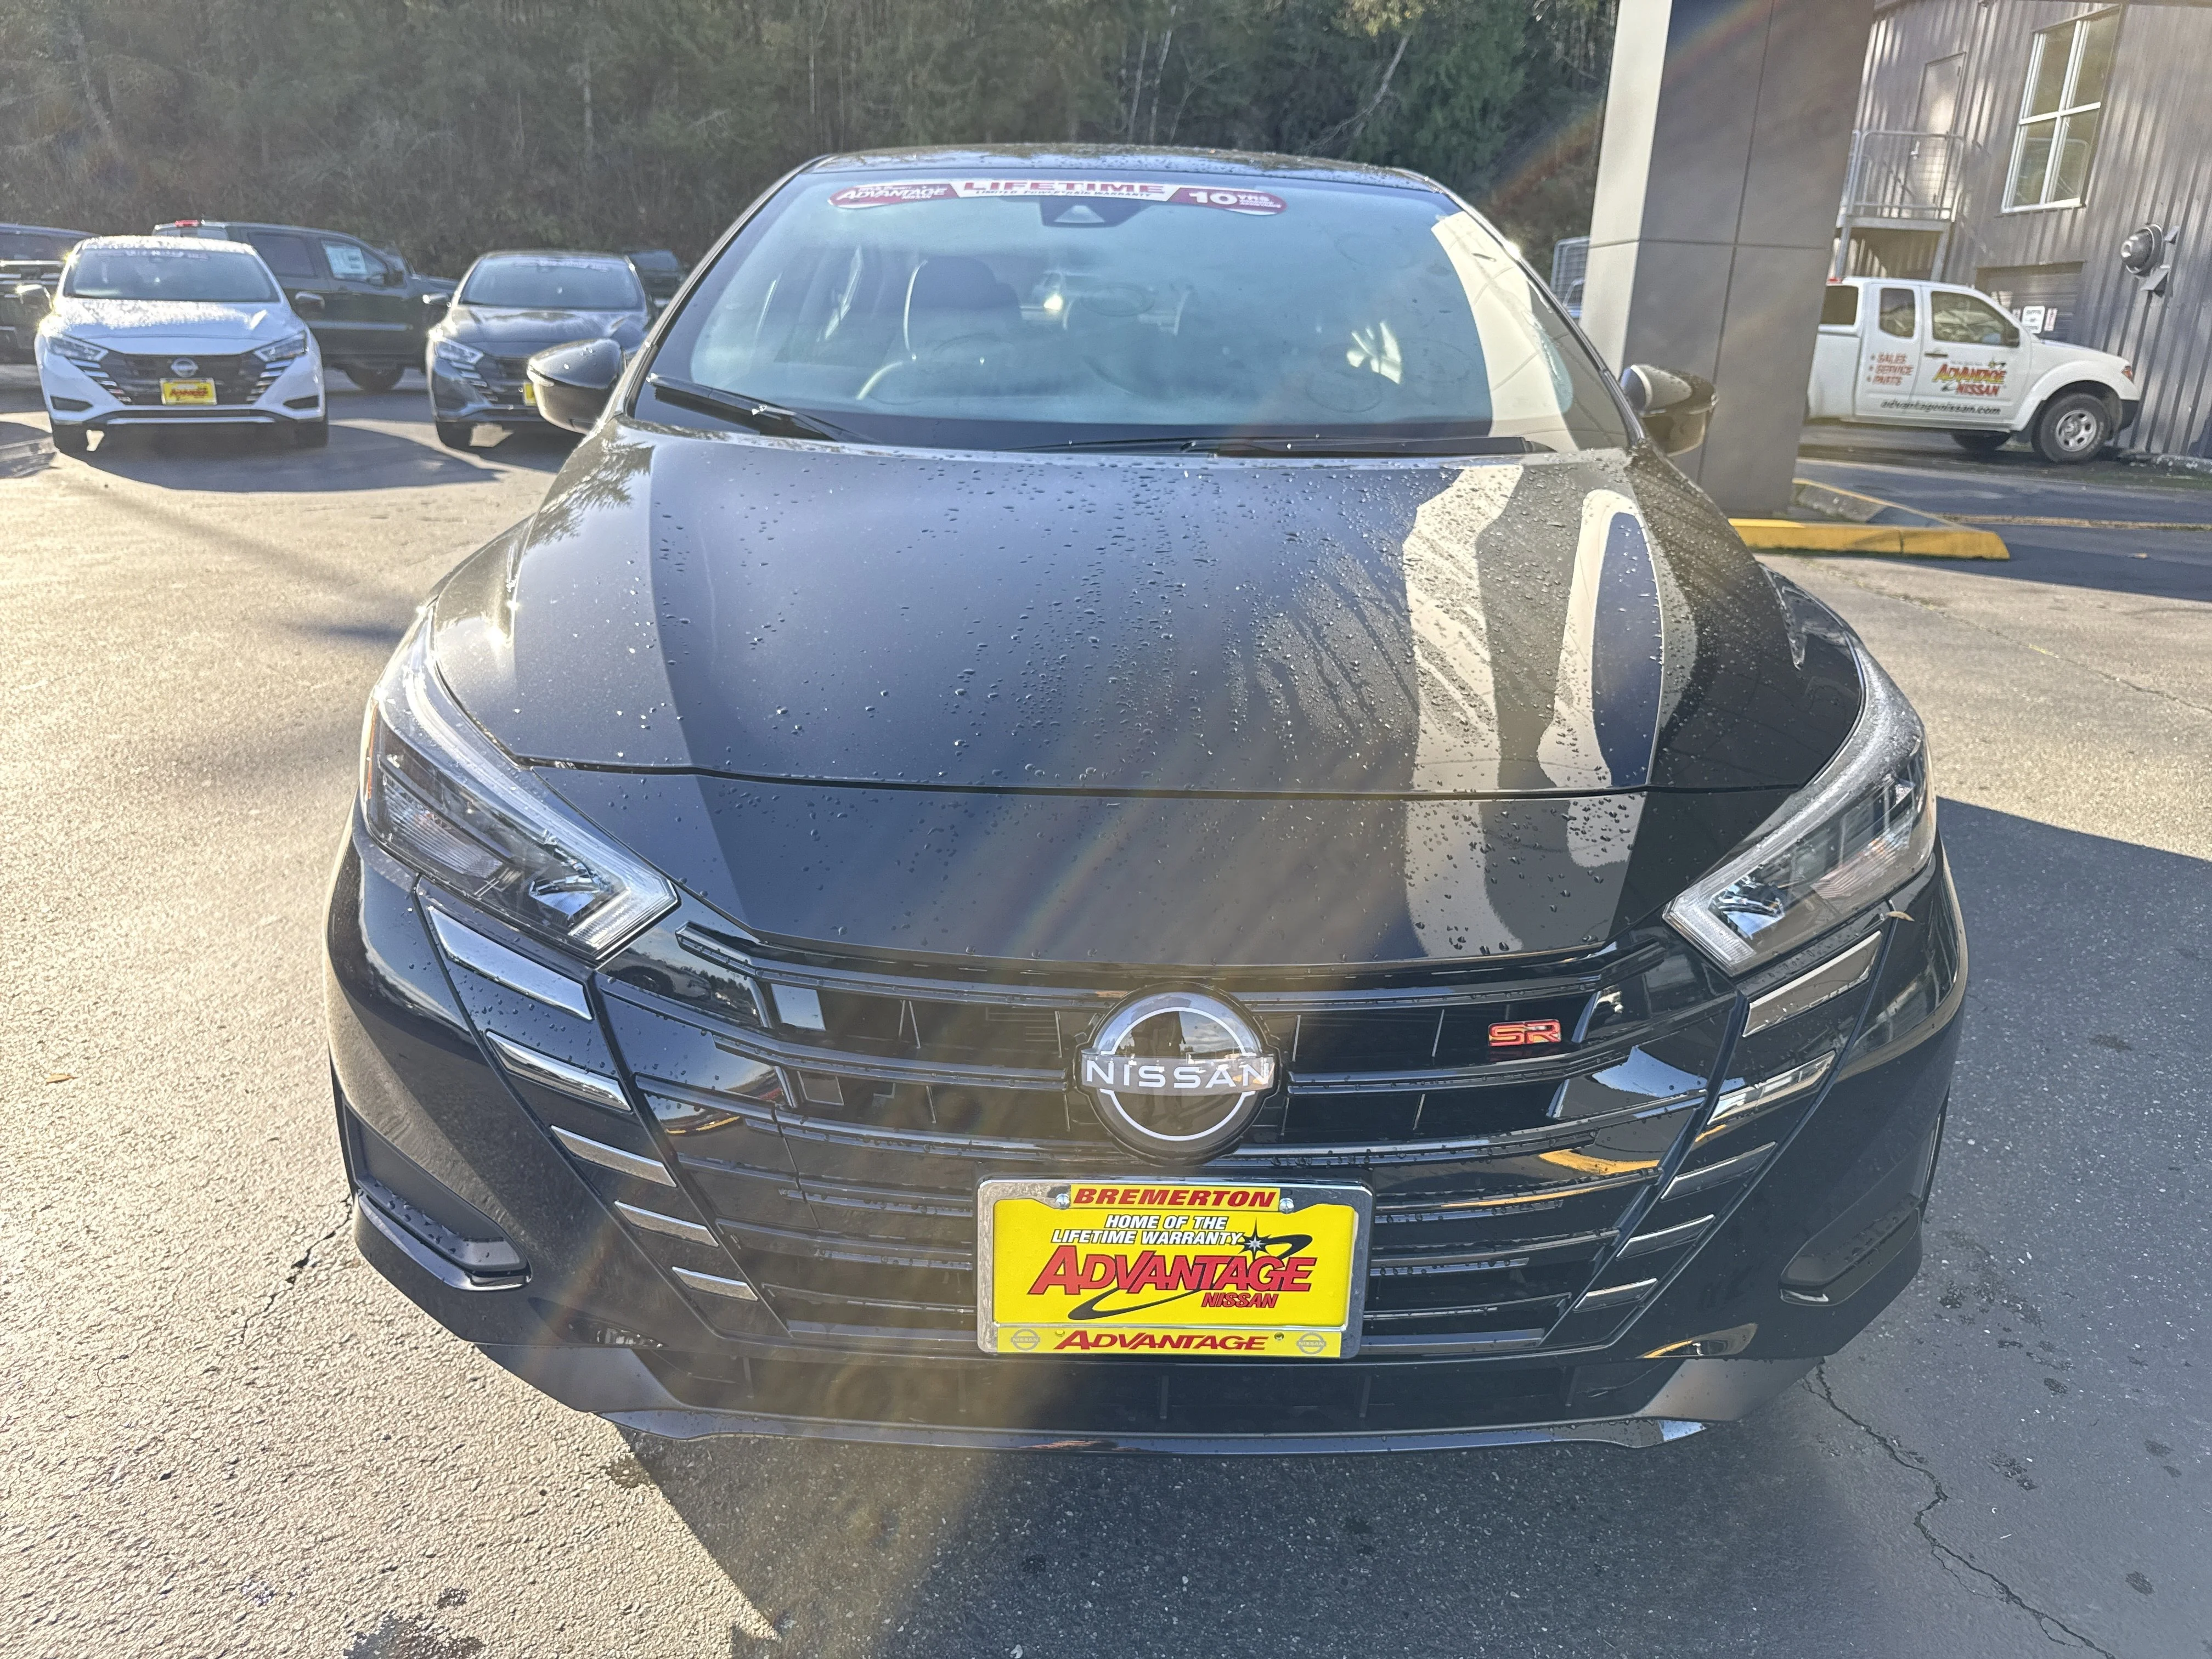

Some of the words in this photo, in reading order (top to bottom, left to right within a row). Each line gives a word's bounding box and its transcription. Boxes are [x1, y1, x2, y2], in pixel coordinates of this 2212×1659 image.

[836, 187, 947, 200] ADVANTAGE
[964, 182, 1165, 194] LIFETIME
[1189, 191, 1238, 205] 10
[1932, 364, 2007, 384] ADVANTAGE
[1955, 384, 2001, 397] NISSAN
[1488, 1019, 1561, 1047] SR
[1086, 1059, 1270, 1089] NISSAN
[1072, 1188, 1277, 1207] BREMERTON
[1105, 1215, 1159, 1229] HOME
[1163, 1215, 1188, 1229] OF
[1192, 1216, 1229, 1230] THE
[1051, 1229, 1140, 1244] LIFETIME
[1141, 1231, 1244, 1246] WARRANTY
[1027, 1245, 1318, 1295] ADVANTAGE
[1200, 1292, 1279, 1308] NISSAN
[1053, 1330, 1269, 1350] ADVANTAGE
